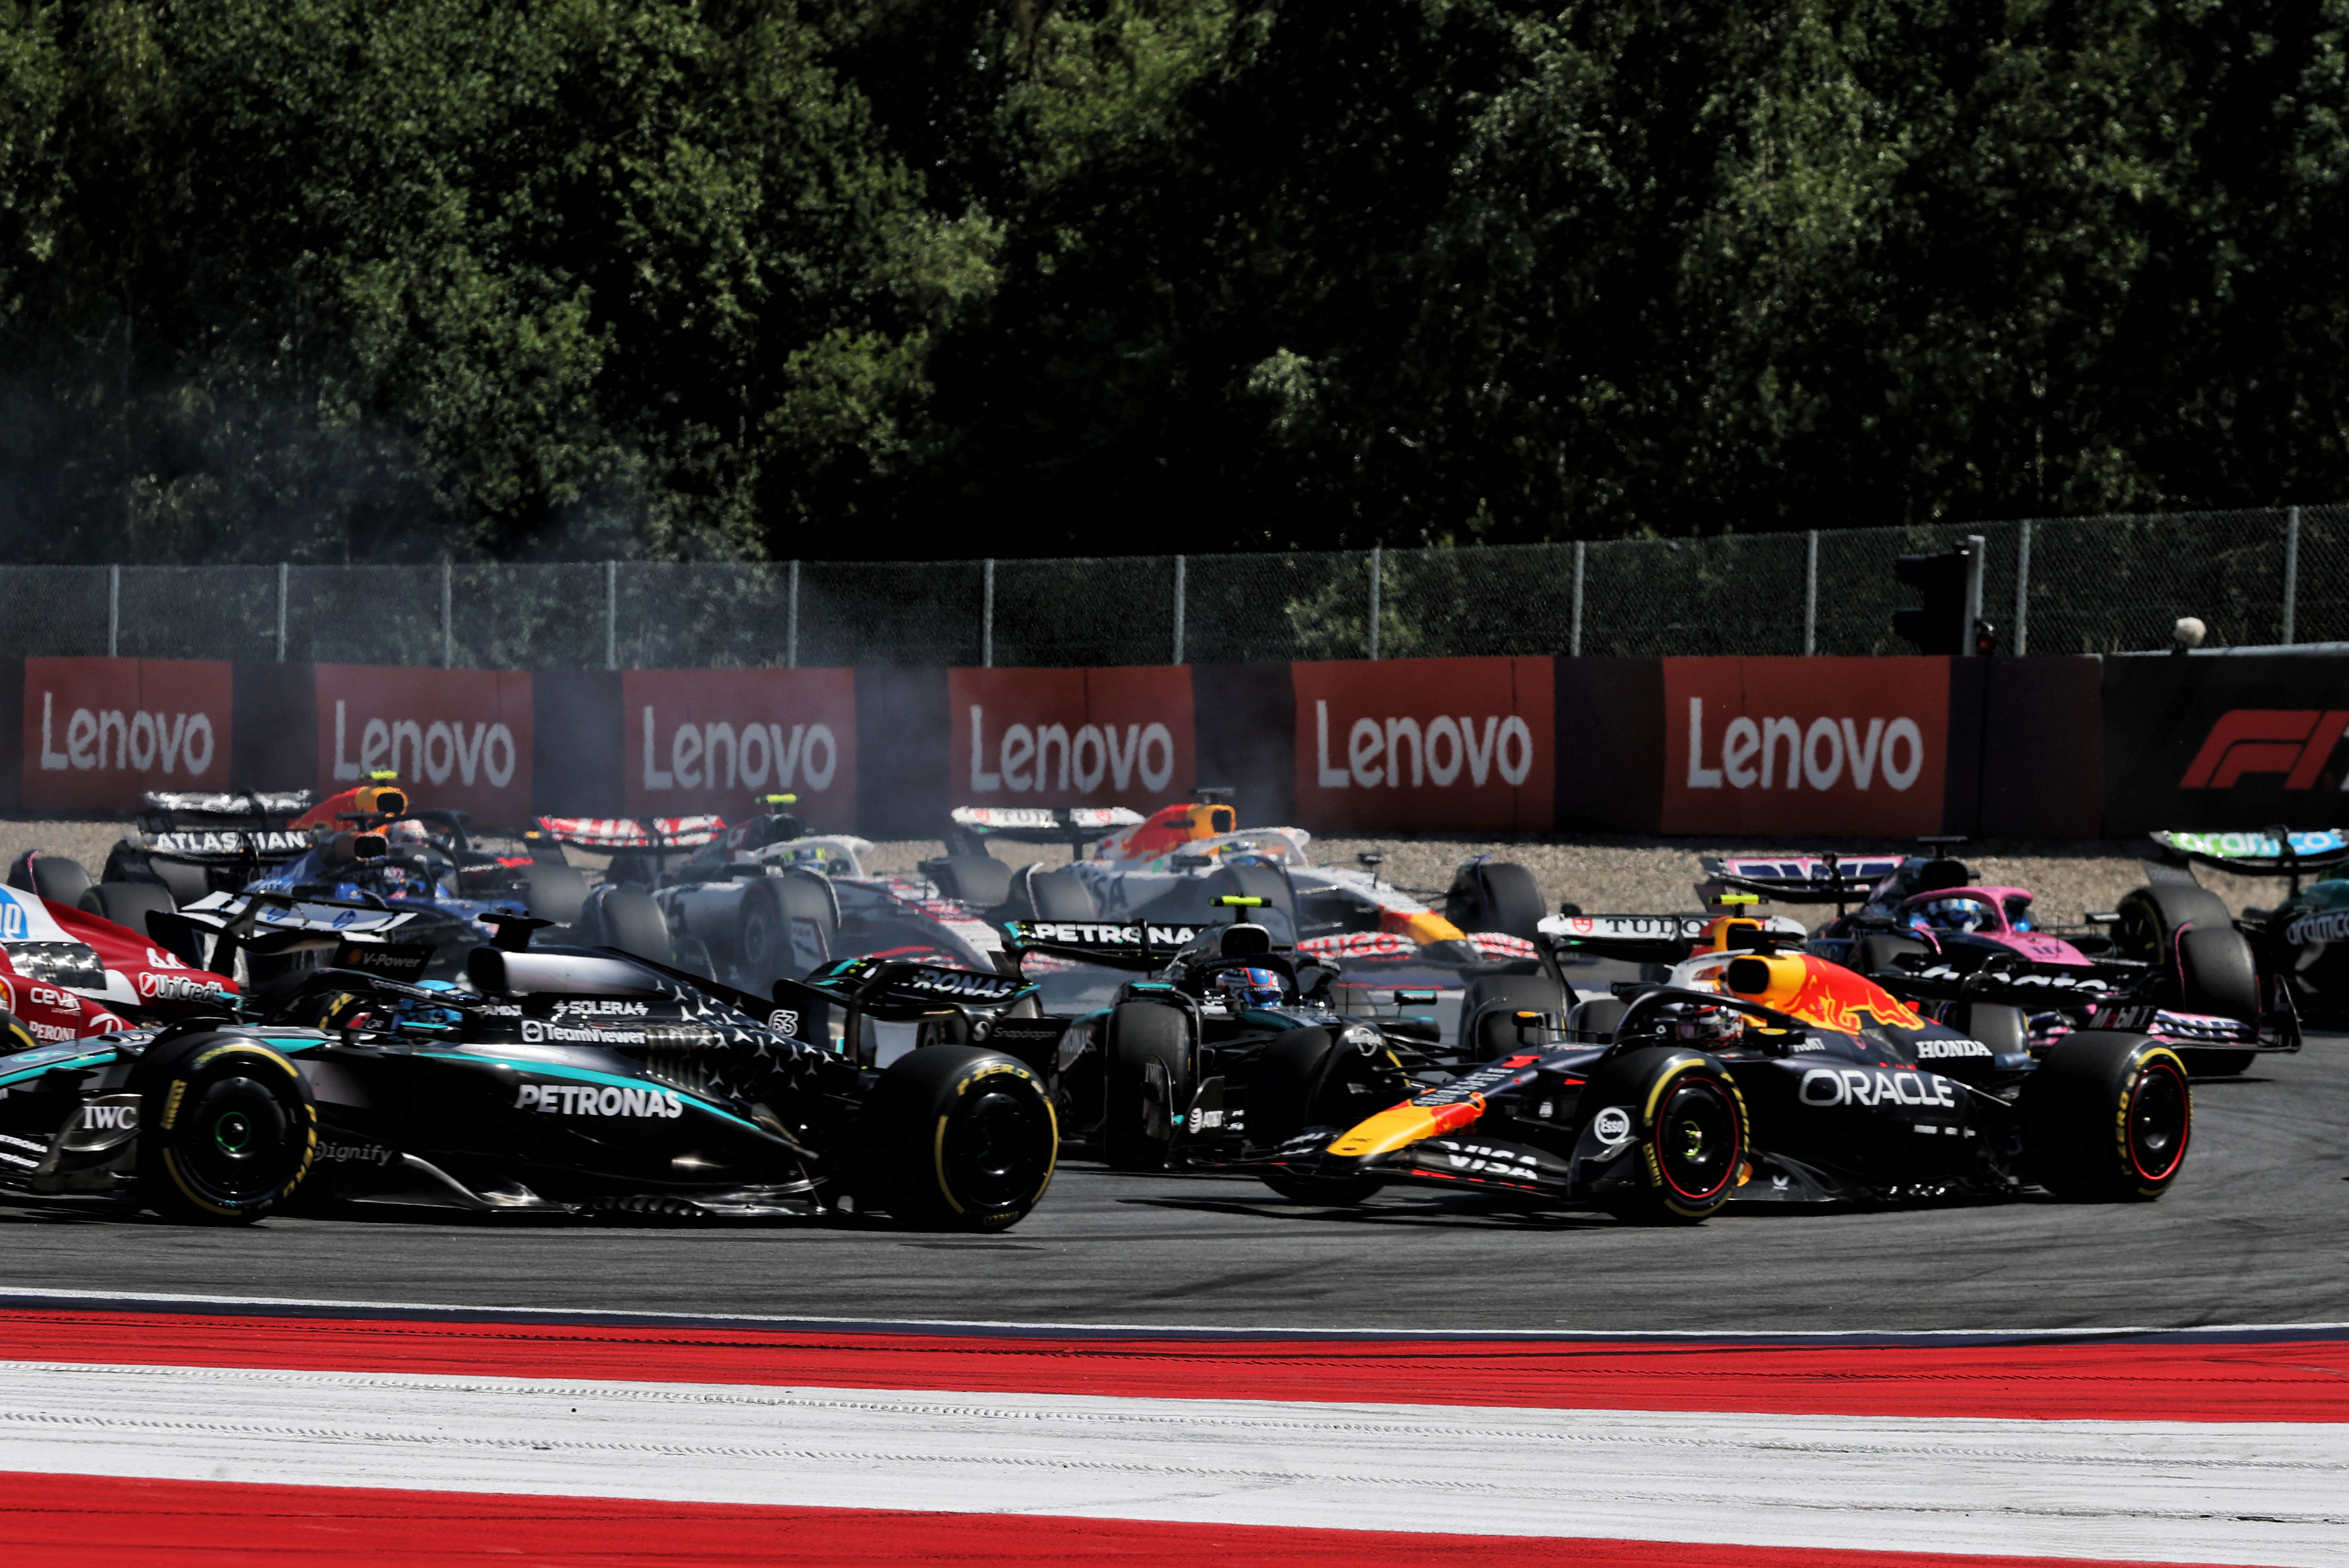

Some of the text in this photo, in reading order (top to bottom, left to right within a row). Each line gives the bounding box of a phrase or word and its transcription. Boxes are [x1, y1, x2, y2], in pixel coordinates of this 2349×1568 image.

[41, 691, 213, 775] Lenovo
[334, 700, 516, 788] Lenovo
[644, 705, 837, 792] Lenovo
[970, 704, 1174, 793] Lenovo
[1316, 700, 1533, 788] Lenovo
[1687, 697, 1924, 791] Lenovo
[2180, 709, 2349, 790] F1
[157, 832, 307, 852] ATLASIAN
[1035, 923, 1203, 945] PETRONA
[1606, 919, 1705, 934] TUDO
[912, 969, 1018, 999] RONAS
[569, 1000, 636, 1015] SOLERA
[768, 1009, 799, 1037] 63
[542, 1023, 646, 1044] TeamViewer
[1915, 1040, 1993, 1058] HONDA
[513, 1084, 683, 1119] PETRONAS
[1798, 1068, 1955, 1107] ORACLE
[84, 1106, 136, 1129] IWC
